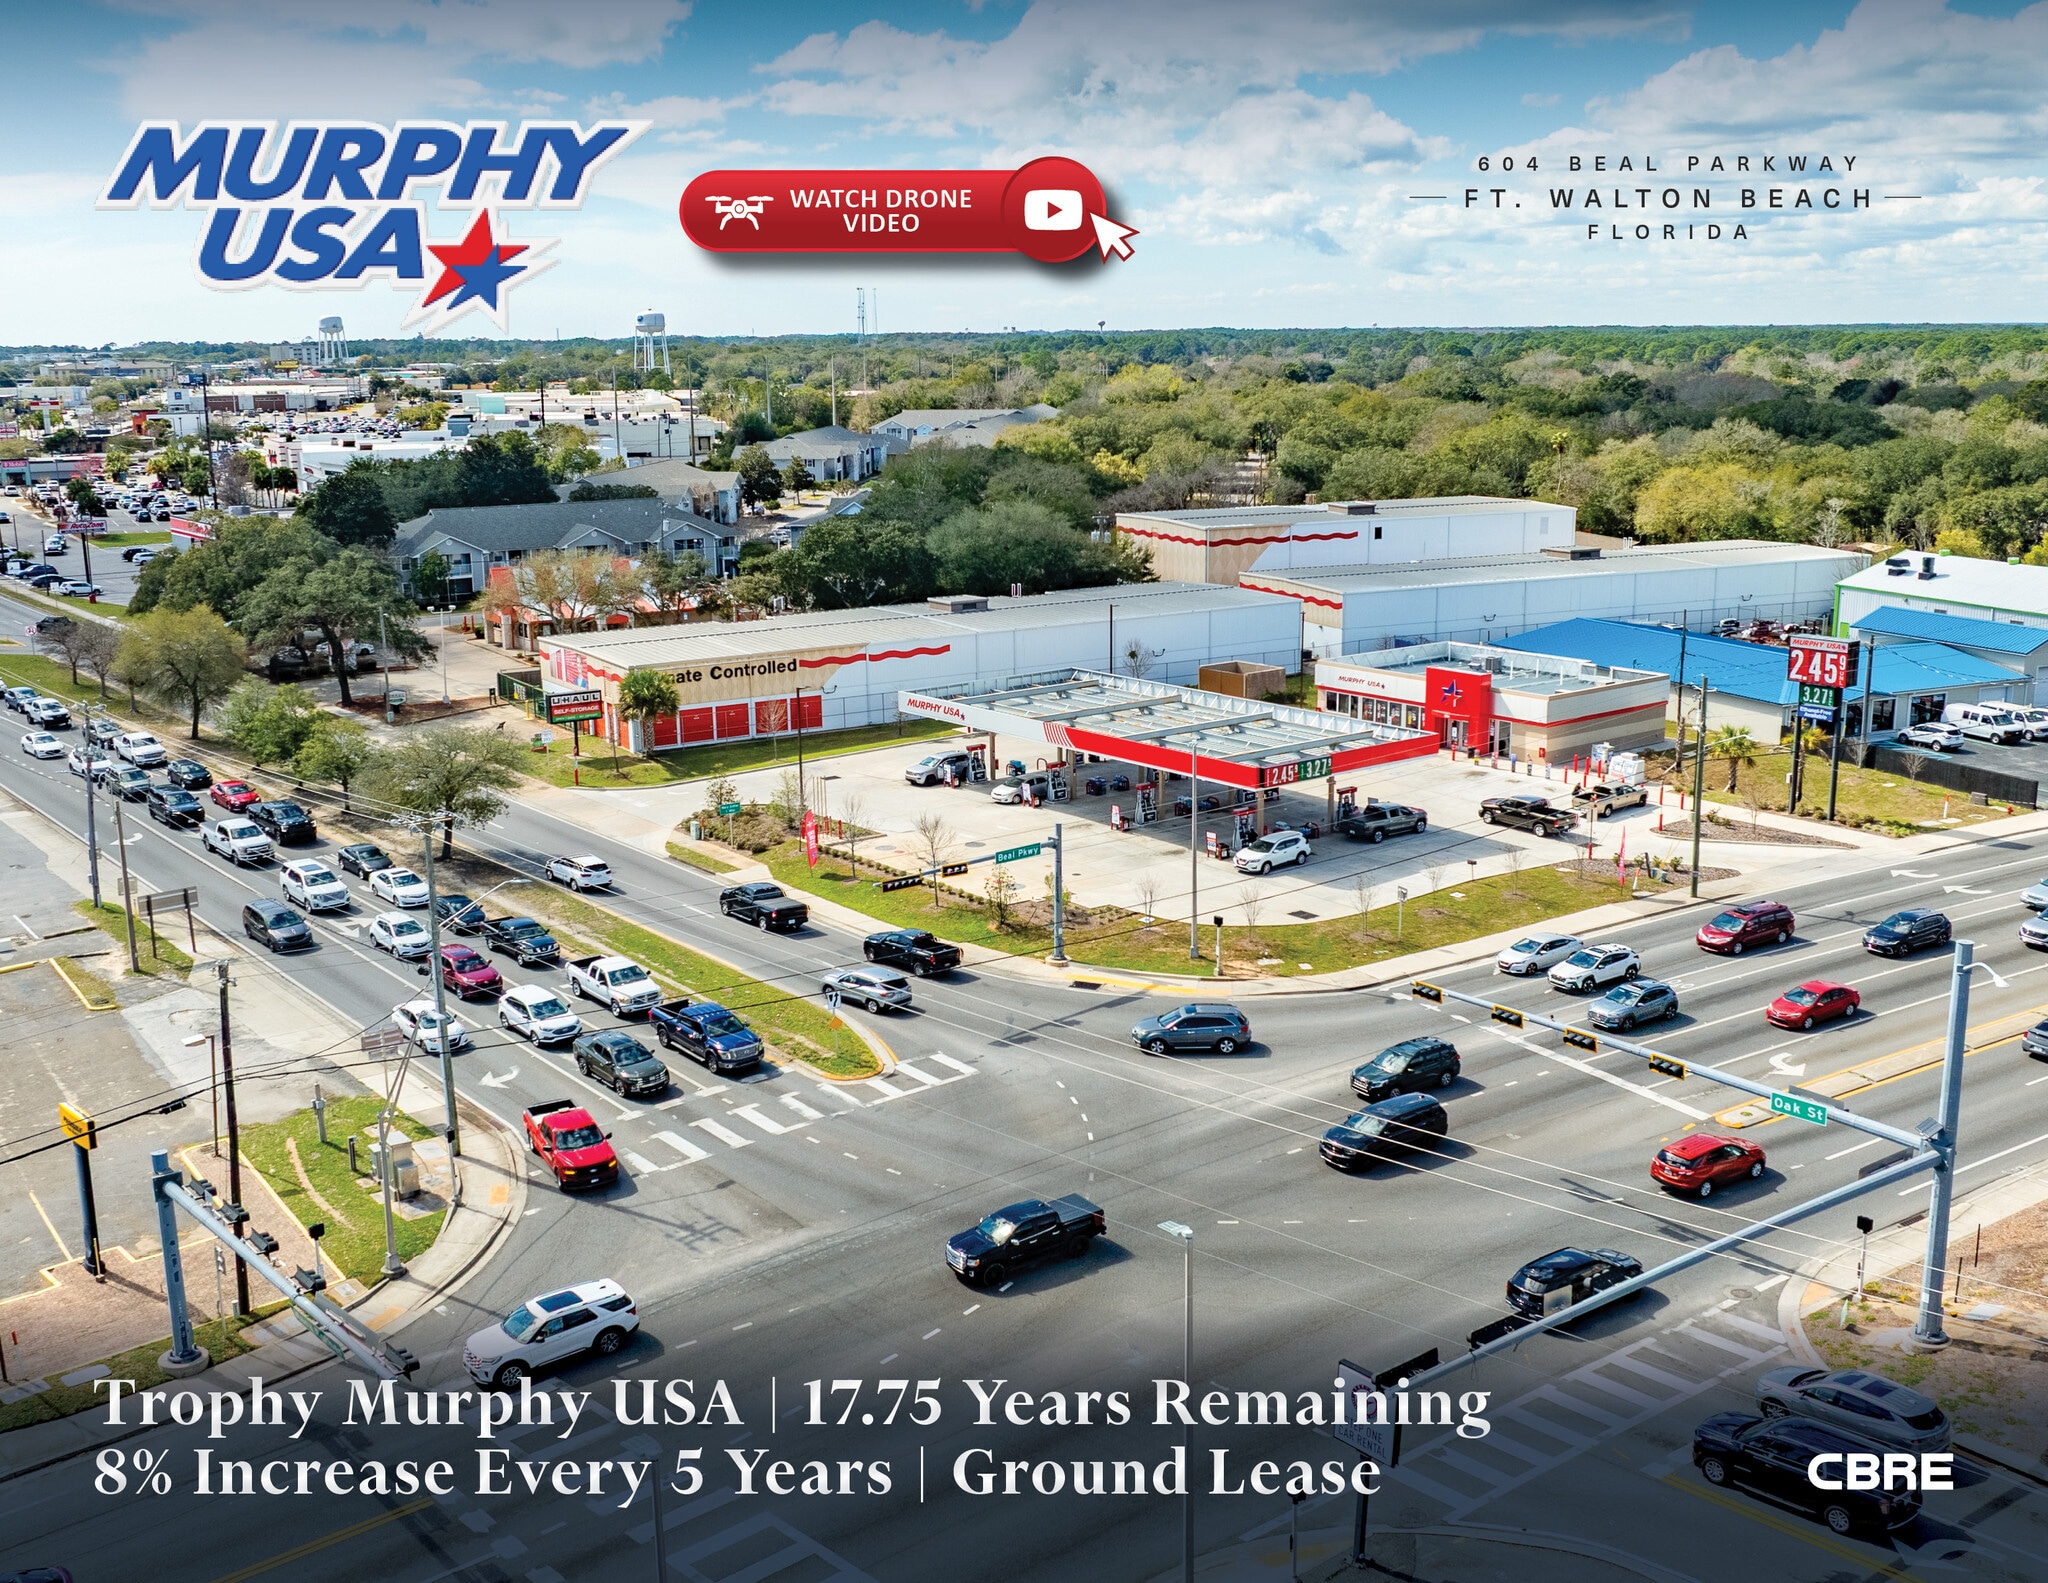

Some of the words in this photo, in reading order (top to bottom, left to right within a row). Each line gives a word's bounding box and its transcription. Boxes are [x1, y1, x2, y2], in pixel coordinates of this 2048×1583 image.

[70, 521, 104, 529] AutoZone
[1792, 639, 1824, 648] MURPHY
[671, 668, 703, 684] ate
[709, 658, 797, 680] Controlled
[1338, 675, 1365, 685] MURPHY
[554, 705, 600, 715] SELF-STORAGE
[907, 698, 942, 713] MURPHY
[943, 706, 961, 718] USA
[998, 851, 1015, 862] Beal
[1018, 847, 1039, 857] Pkwy
[1774, 1097, 1801, 1114] Oak
[1807, 1107, 1824, 1121] St
[1338, 1425, 1355, 1441] CAR
[1356, 1434, 1387, 1459] RENTAL
[1366, 1427, 1383, 1444] ONE
